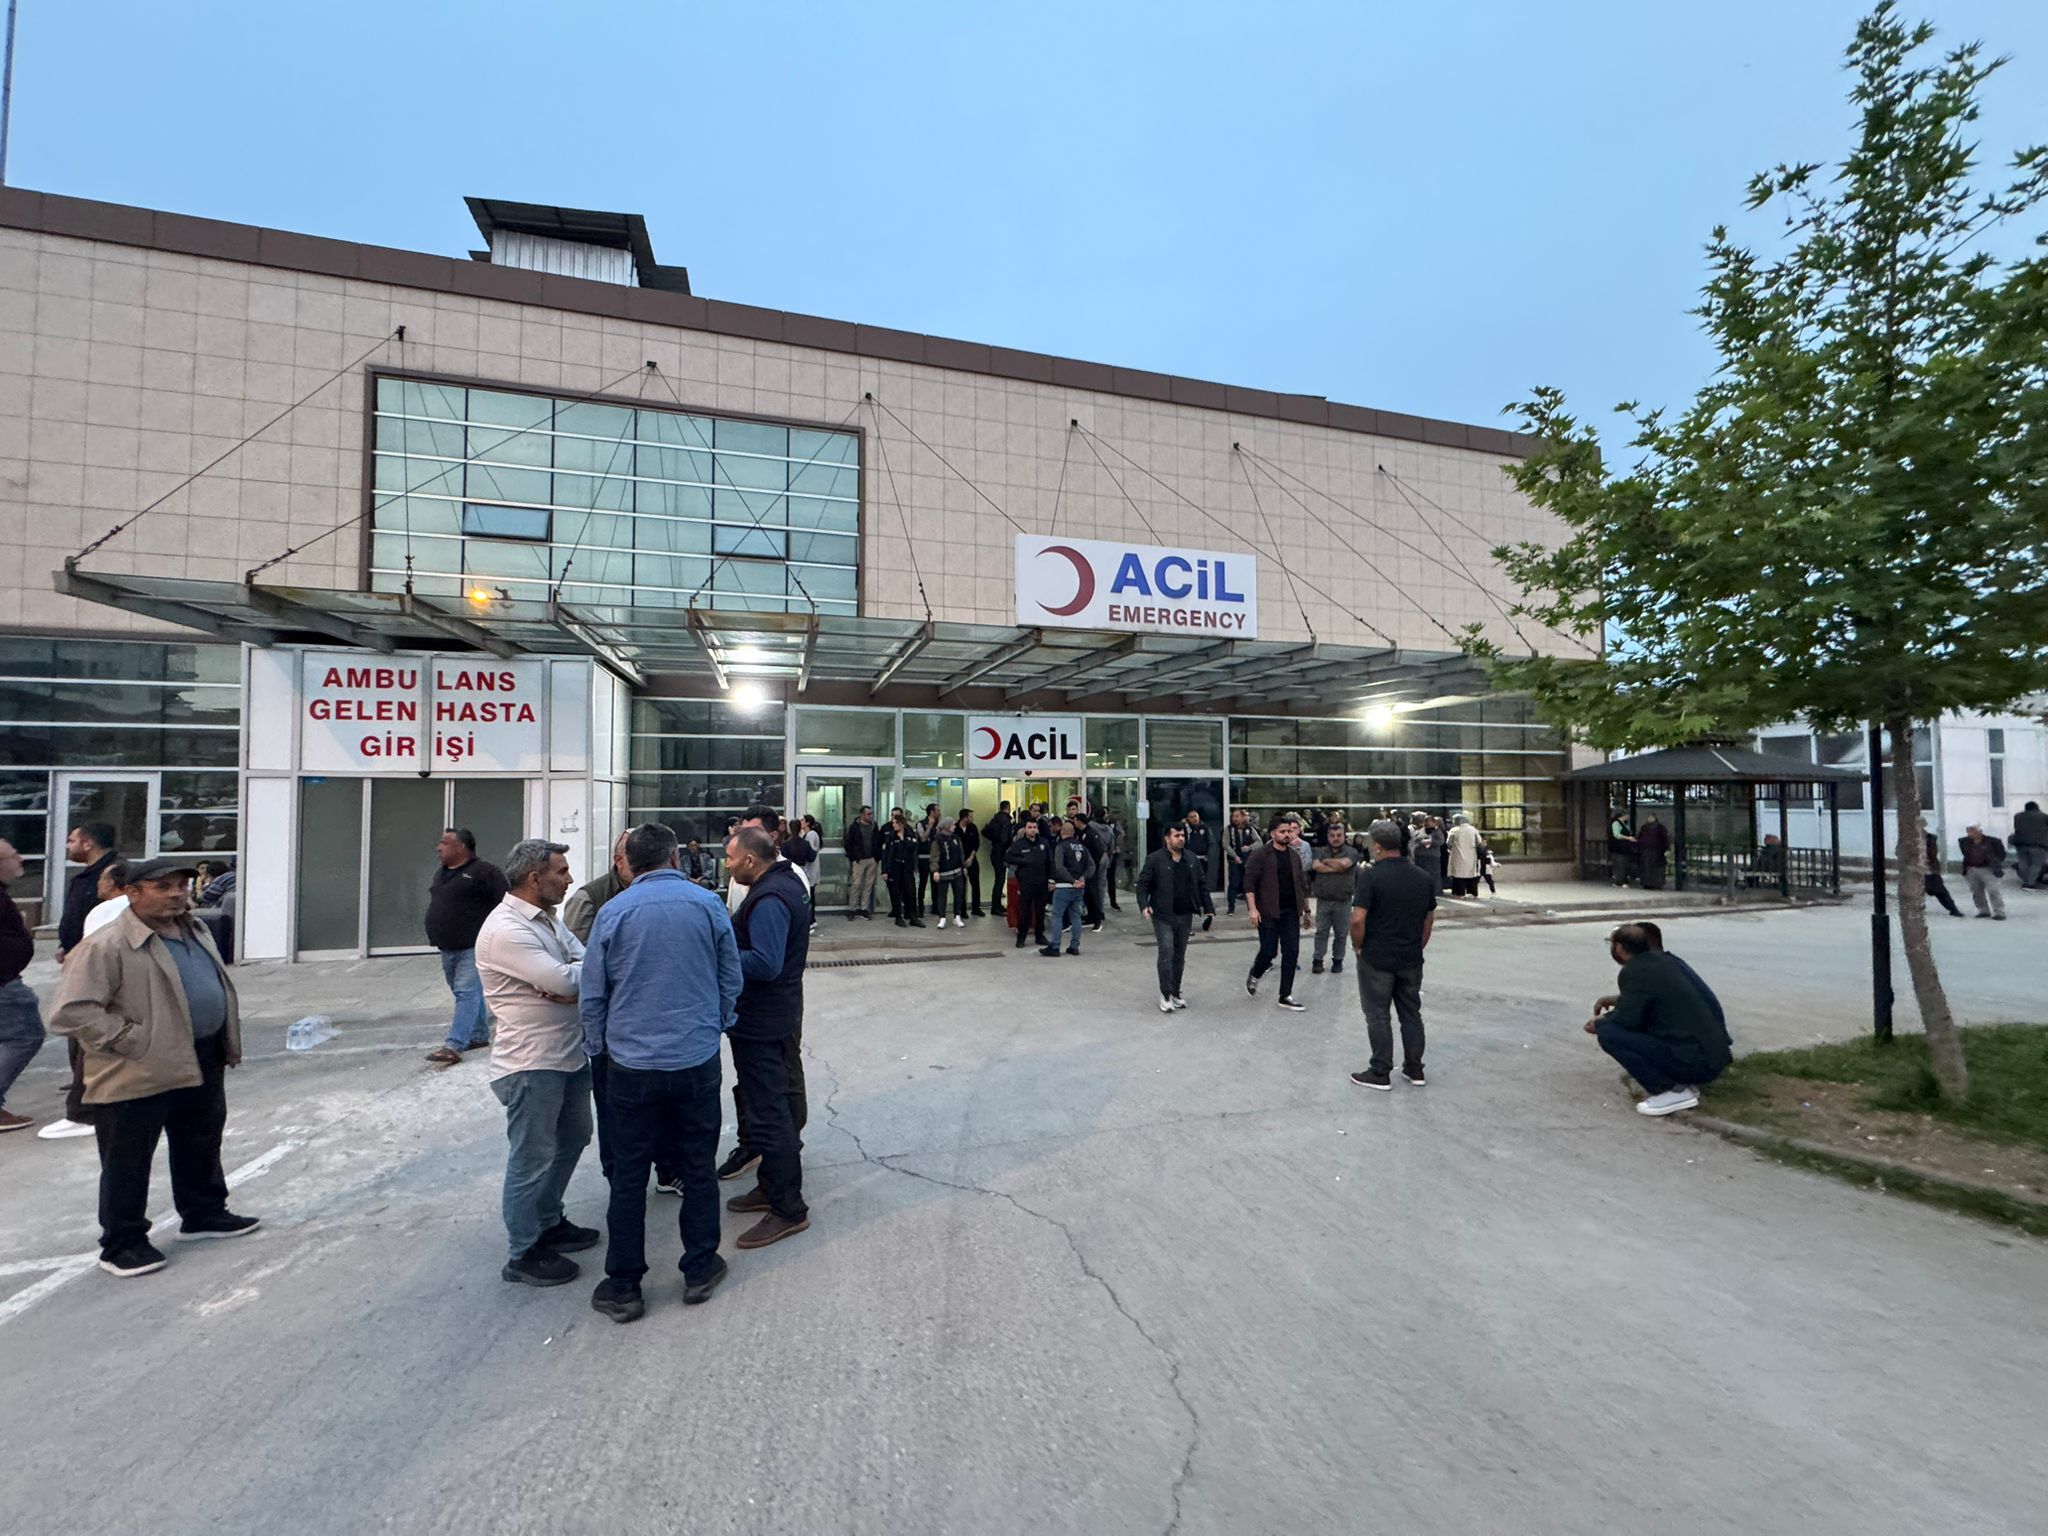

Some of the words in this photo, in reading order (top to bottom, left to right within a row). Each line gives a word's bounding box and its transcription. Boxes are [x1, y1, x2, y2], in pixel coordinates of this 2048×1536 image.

[1108, 604, 1247, 630] EMERGENCY
[309, 699, 417, 721] GELEN
[436, 702, 536, 722] HASTA
[1003, 727, 1078, 760] ACİL
